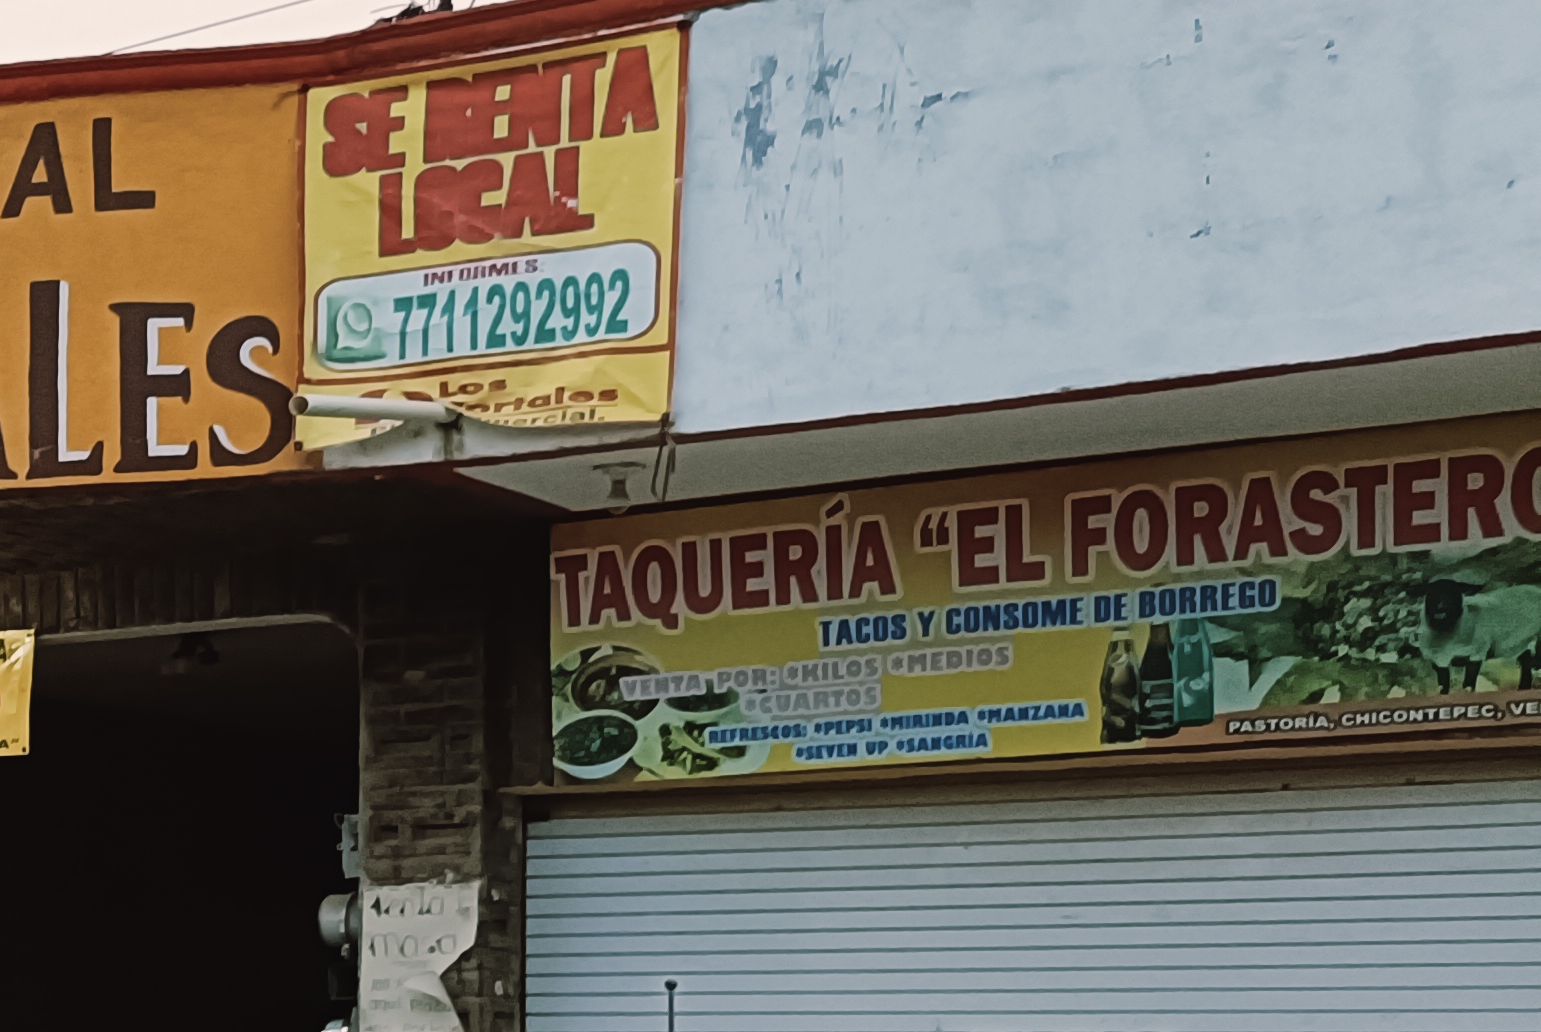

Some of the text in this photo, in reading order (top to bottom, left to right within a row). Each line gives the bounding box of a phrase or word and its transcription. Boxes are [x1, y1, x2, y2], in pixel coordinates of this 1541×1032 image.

[323, 45, 659, 177] SE RENTA
[379, 146, 595, 257] LOCAL
[392, 268, 630, 360] 7711292992
[439, 379, 508, 398] Los
[450, 386, 619, 413] ortales
[554, 498, 897, 631] TAQUERÍA
[819, 578, 1278, 648] TACOS Y CONSOME DE BORREGO
[623, 674, 702, 697] VENTA
[1341, 703, 1503, 727] CHICONTEPEC,
[1509, 701, 1541, 716] VE
[865, 740, 889, 755] UP
